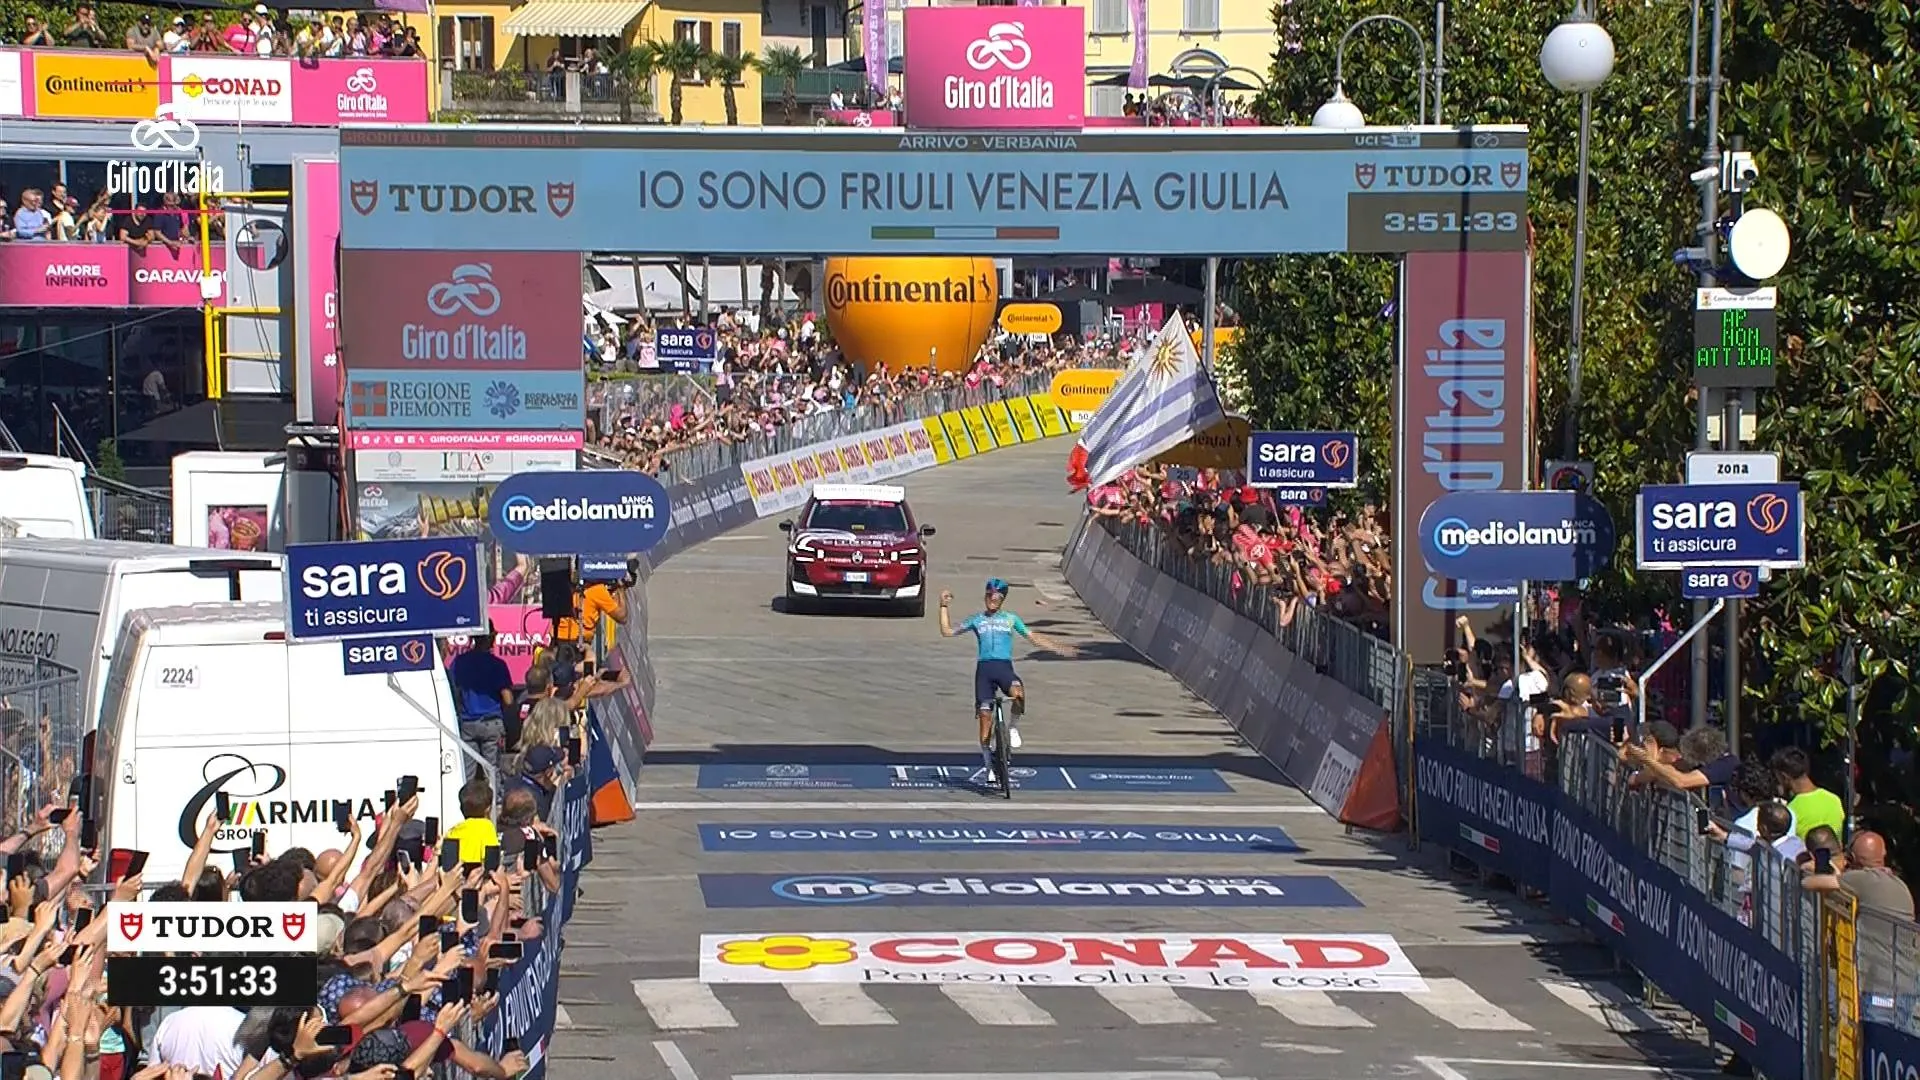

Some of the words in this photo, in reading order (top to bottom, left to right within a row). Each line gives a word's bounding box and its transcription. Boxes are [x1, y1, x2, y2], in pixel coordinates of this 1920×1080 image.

[45, 74, 134, 95] Continental
[205, 77, 281, 96] CONAD
[944, 75, 986, 109] Giro
[988, 75, 1054, 109] d'Italia
[337, 94, 356, 110] Giro
[357, 94, 387, 111] d'Italia
[898, 135, 968, 149] ARRIVO
[982, 135, 1078, 150] VERBANIA
[1355, 135, 1378, 146] UCI
[1383, 164, 1493, 187] TUDOR
[388, 183, 538, 213] TUDOR
[638, 169, 685, 210] IO
[697, 169, 827, 210] SONO
[840, 171, 954, 212] FRIULI
[966, 170, 1142, 211] VENEZIA
[1153, 170, 1290, 211] GIULIA
[1384, 211, 1518, 233] 3:51:33
[45, 264, 102, 276] AMORE
[45, 276, 108, 287] INFINITO
[828, 273, 975, 310] Continental
[1007, 313, 1048, 324] Continental
[402, 324, 450, 361] Giro
[453, 324, 527, 361] d'Italia
[660, 333, 694, 347] sara
[1697, 347, 1771, 367] ATTIVA
[390, 382, 472, 400] REGIONE
[1060, 384, 1110, 396] Continent
[390, 401, 472, 417] PIEMONTE
[1078, 413, 1089, 421] 50
[430, 434, 501, 444] GIRODITALIA.IT
[505, 433, 576, 443] #GIRODITALIA
[441, 451, 485, 471] ITA
[1259, 442, 1316, 463] sara
[1176, 470, 1190, 480] 25
[1258, 468, 1267, 478] ti
[1268, 467, 1315, 479] assicura
[1716, 462, 1749, 475] zona
[621, 495, 653, 505] BANCA
[1280, 489, 1308, 501] sara
[508, 497, 655, 522] mediolanum
[1652, 500, 1737, 530] sara
[1652, 537, 1665, 553] ti
[1667, 536, 1737, 553] assicura
[302, 561, 407, 599] sara
[1687, 571, 1729, 588] sara
[304, 609, 319, 627] ti
[323, 606, 408, 626] assicura
[348, 644, 398, 664] sara
[162, 667, 194, 684] 2224
[1426, 759, 1454, 804] SONO
[1454, 768, 1478, 816] FRIULI
[1479, 779, 1517, 833] VENEZIA
[1515, 795, 1550, 847] GIULIA
[719, 829, 758, 840] IO
[769, 829, 879, 840] SONO
[889, 829, 986, 840] FRIULI
[996, 829, 1148, 841] VENEZIA
[1155, 831, 1274, 843] GIULIA
[791, 877, 1286, 898] mediolanum
[1637, 878, 1672, 939] GIULIA
[869, 937, 1391, 970] CONAD
[863, 968, 1054, 985] Persone
[1074, 969, 1187, 986] oltre
[1211, 971, 1250, 987] le
[1272, 975, 1382, 989] cose
